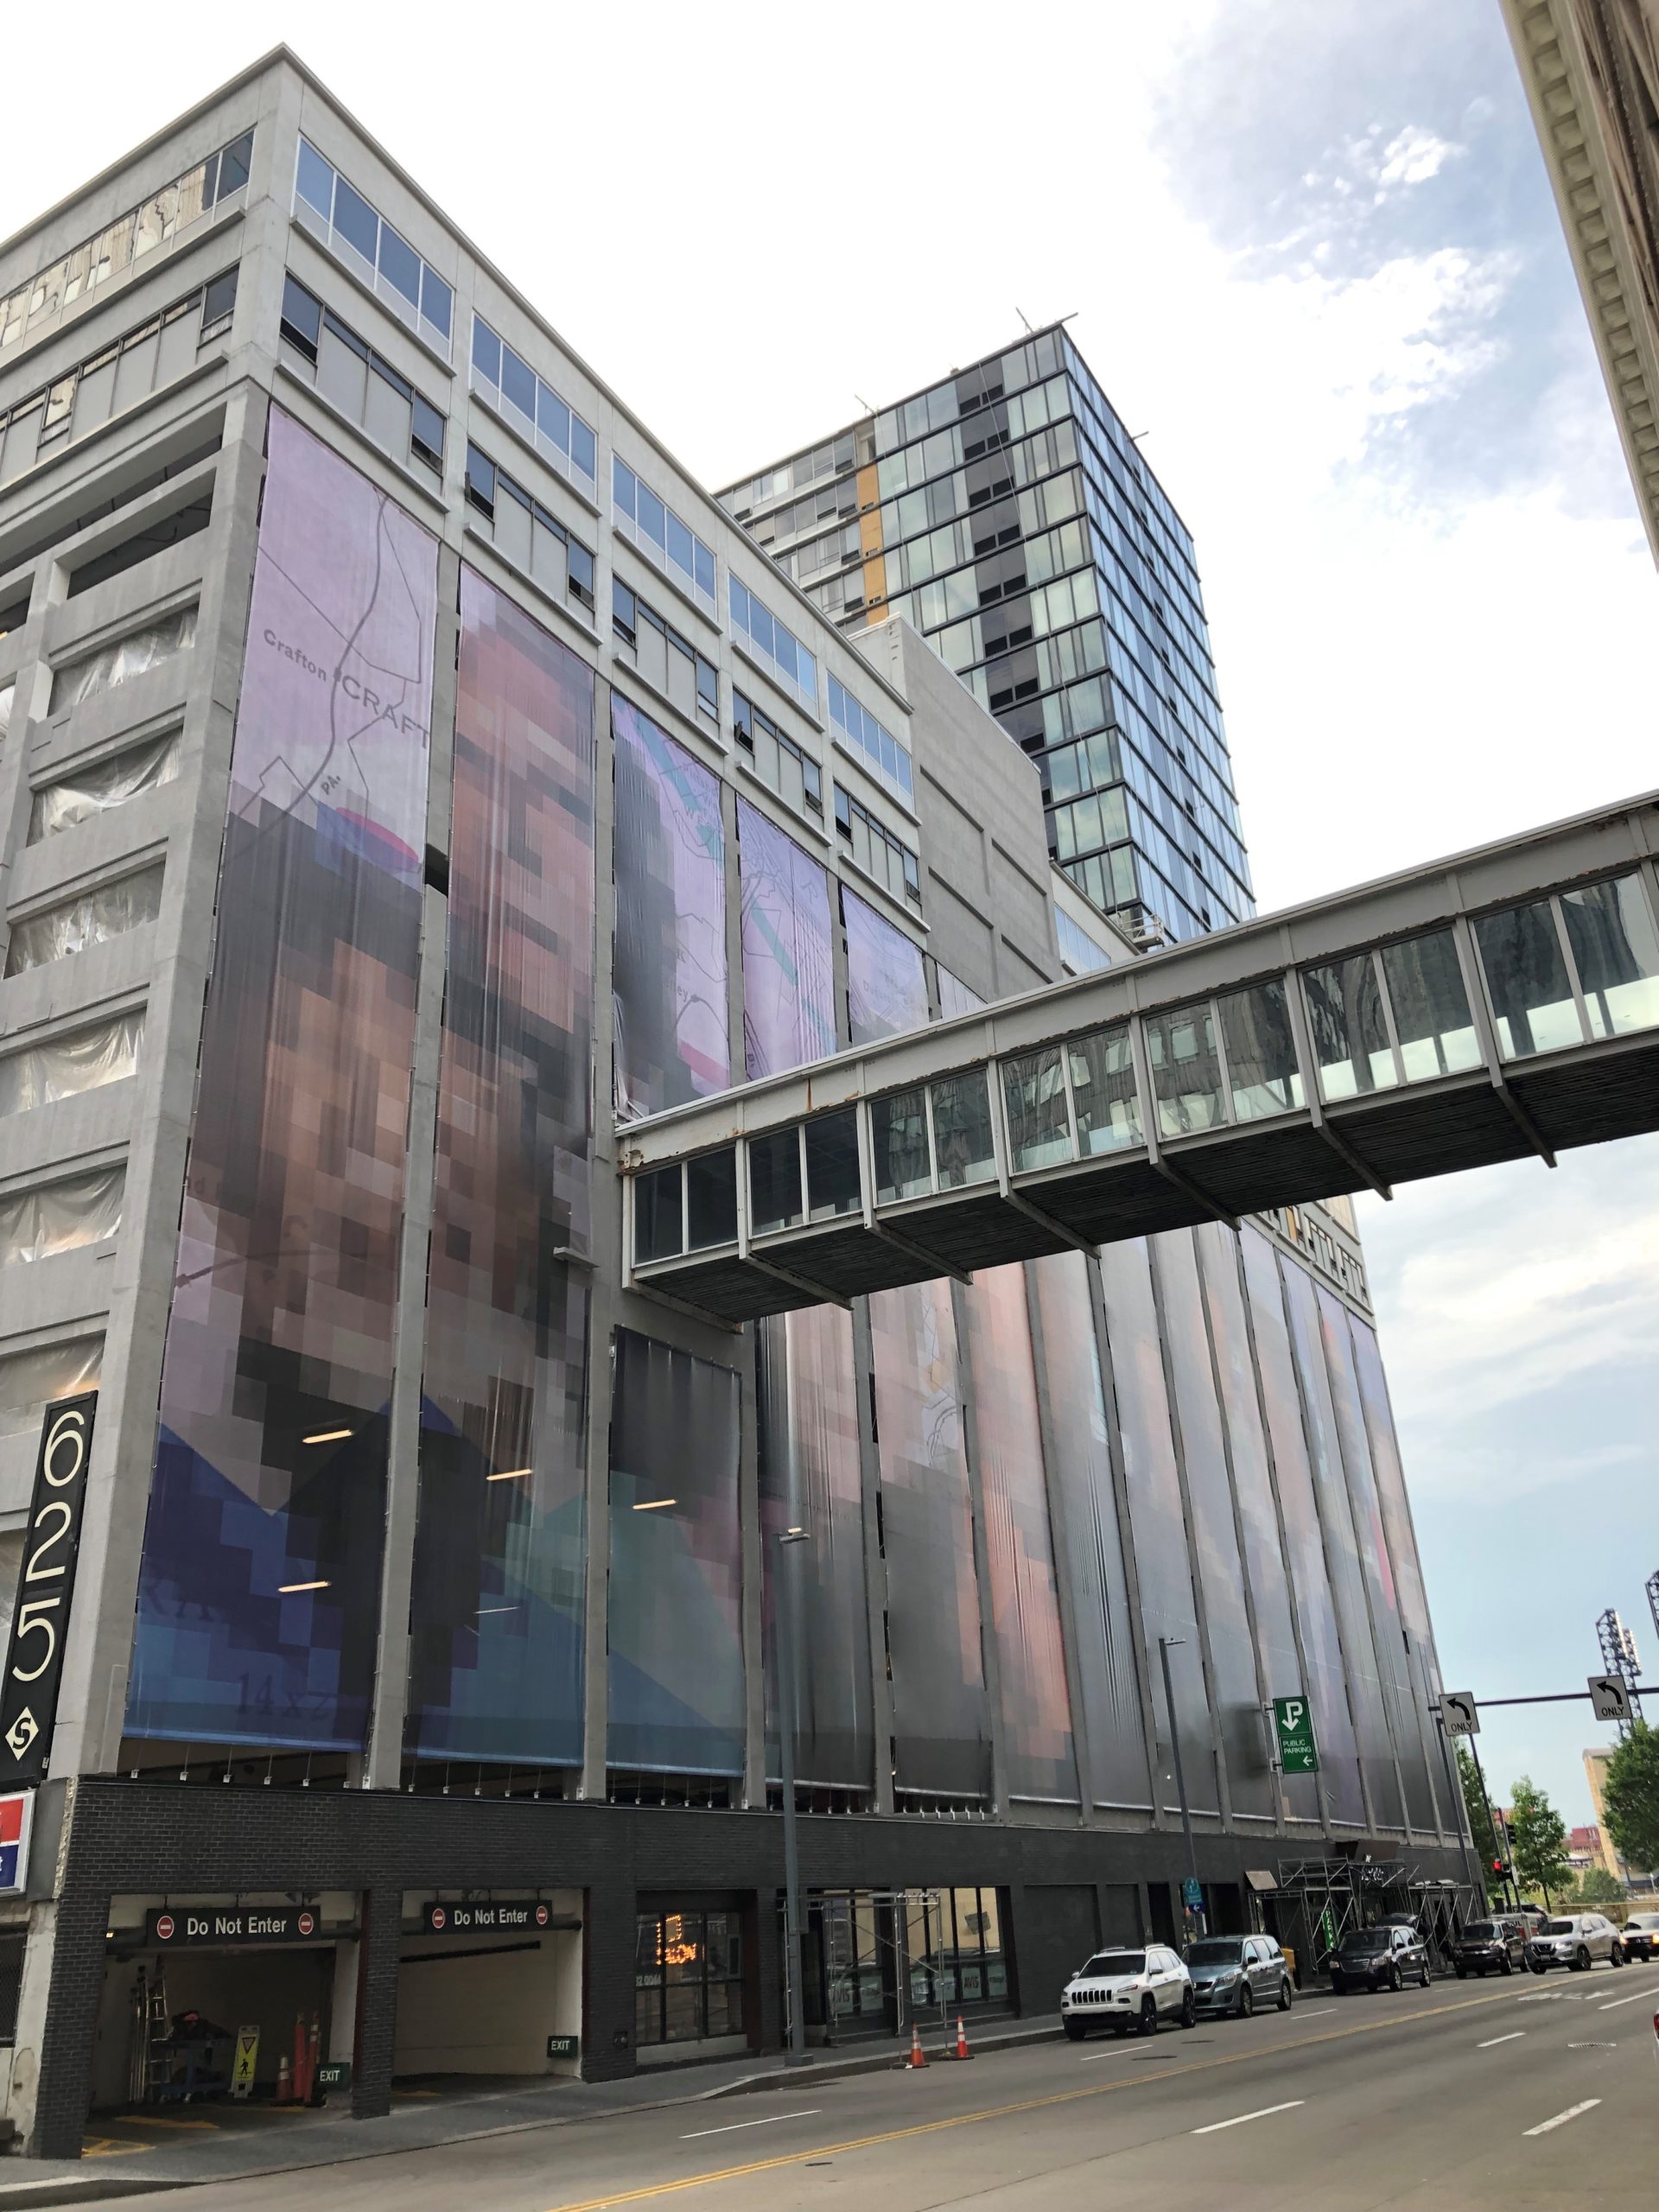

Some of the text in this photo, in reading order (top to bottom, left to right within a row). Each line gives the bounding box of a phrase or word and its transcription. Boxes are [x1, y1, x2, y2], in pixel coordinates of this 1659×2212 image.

[263, 628, 327, 682] Crafton
[341, 674, 430, 750] CRAFT
[11, 1410, 85, 1682] 625
[1600, 1706, 1625, 1718] ONLY
[1450, 1721, 1473, 1733] ONLY
[1282, 1738, 1306, 1747] PUBLIC
[1283, 1745, 1312, 1755] PARKING
[454, 1908, 528, 1925] Do Not Enter
[187, 1916, 288, 1936] Do Not Enter
[964, 1975, 980, 1989] AVIS
[551, 2040, 570, 2050] EXIT
[319, 2069, 340, 2082] EXIT
